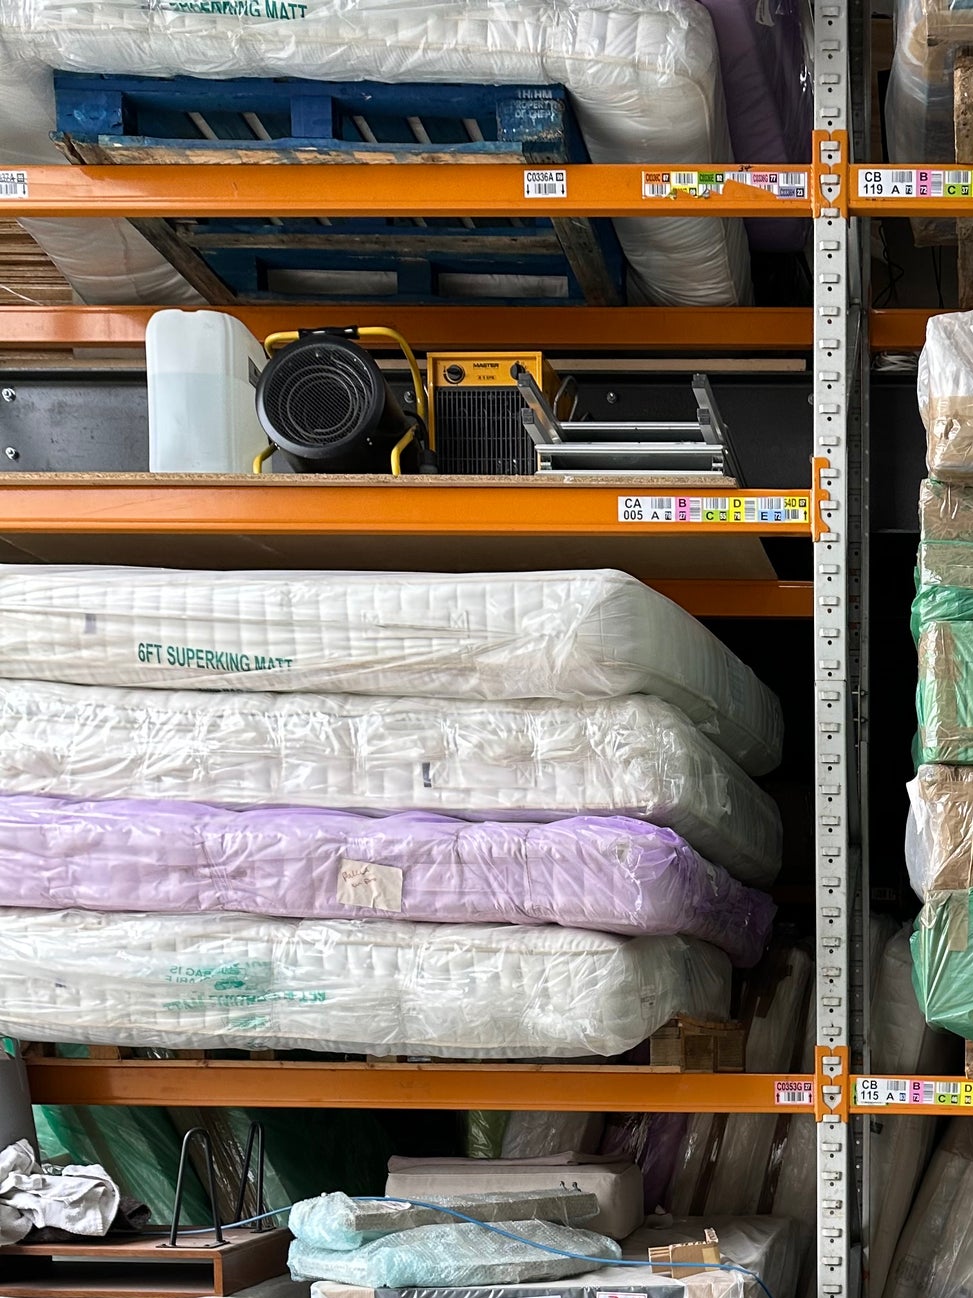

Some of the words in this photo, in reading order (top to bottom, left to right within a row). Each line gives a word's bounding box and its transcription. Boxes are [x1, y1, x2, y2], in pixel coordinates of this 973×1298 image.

[265, 0, 308, 20] MATT
[527, 172, 554, 182] C0336A
[864, 171, 882, 182] CB
[919, 172, 928, 181] B
[863, 184, 883, 195] 119
[891, 185, 900, 194] A
[947, 185, 956, 195] C
[624, 498, 642, 509] CA
[678, 498, 687, 508] B
[733, 499, 742, 508] D
[623, 509, 643, 520] 005
[651, 511, 660, 520] A
[705, 511, 715, 521] C
[760, 511, 768, 521] E
[138, 642, 163, 664] 6FT
[167, 645, 251, 672] SUPERKING
[776, 1082, 803, 1091] C0353G
[861, 1079, 878, 1090] CB
[913, 1081, 921, 1090] B
[964, 1084, 973, 1093] D
[860, 1090, 879, 1101] 115
[886, 1092, 894, 1101] A
[938, 1094, 946, 1103] C
